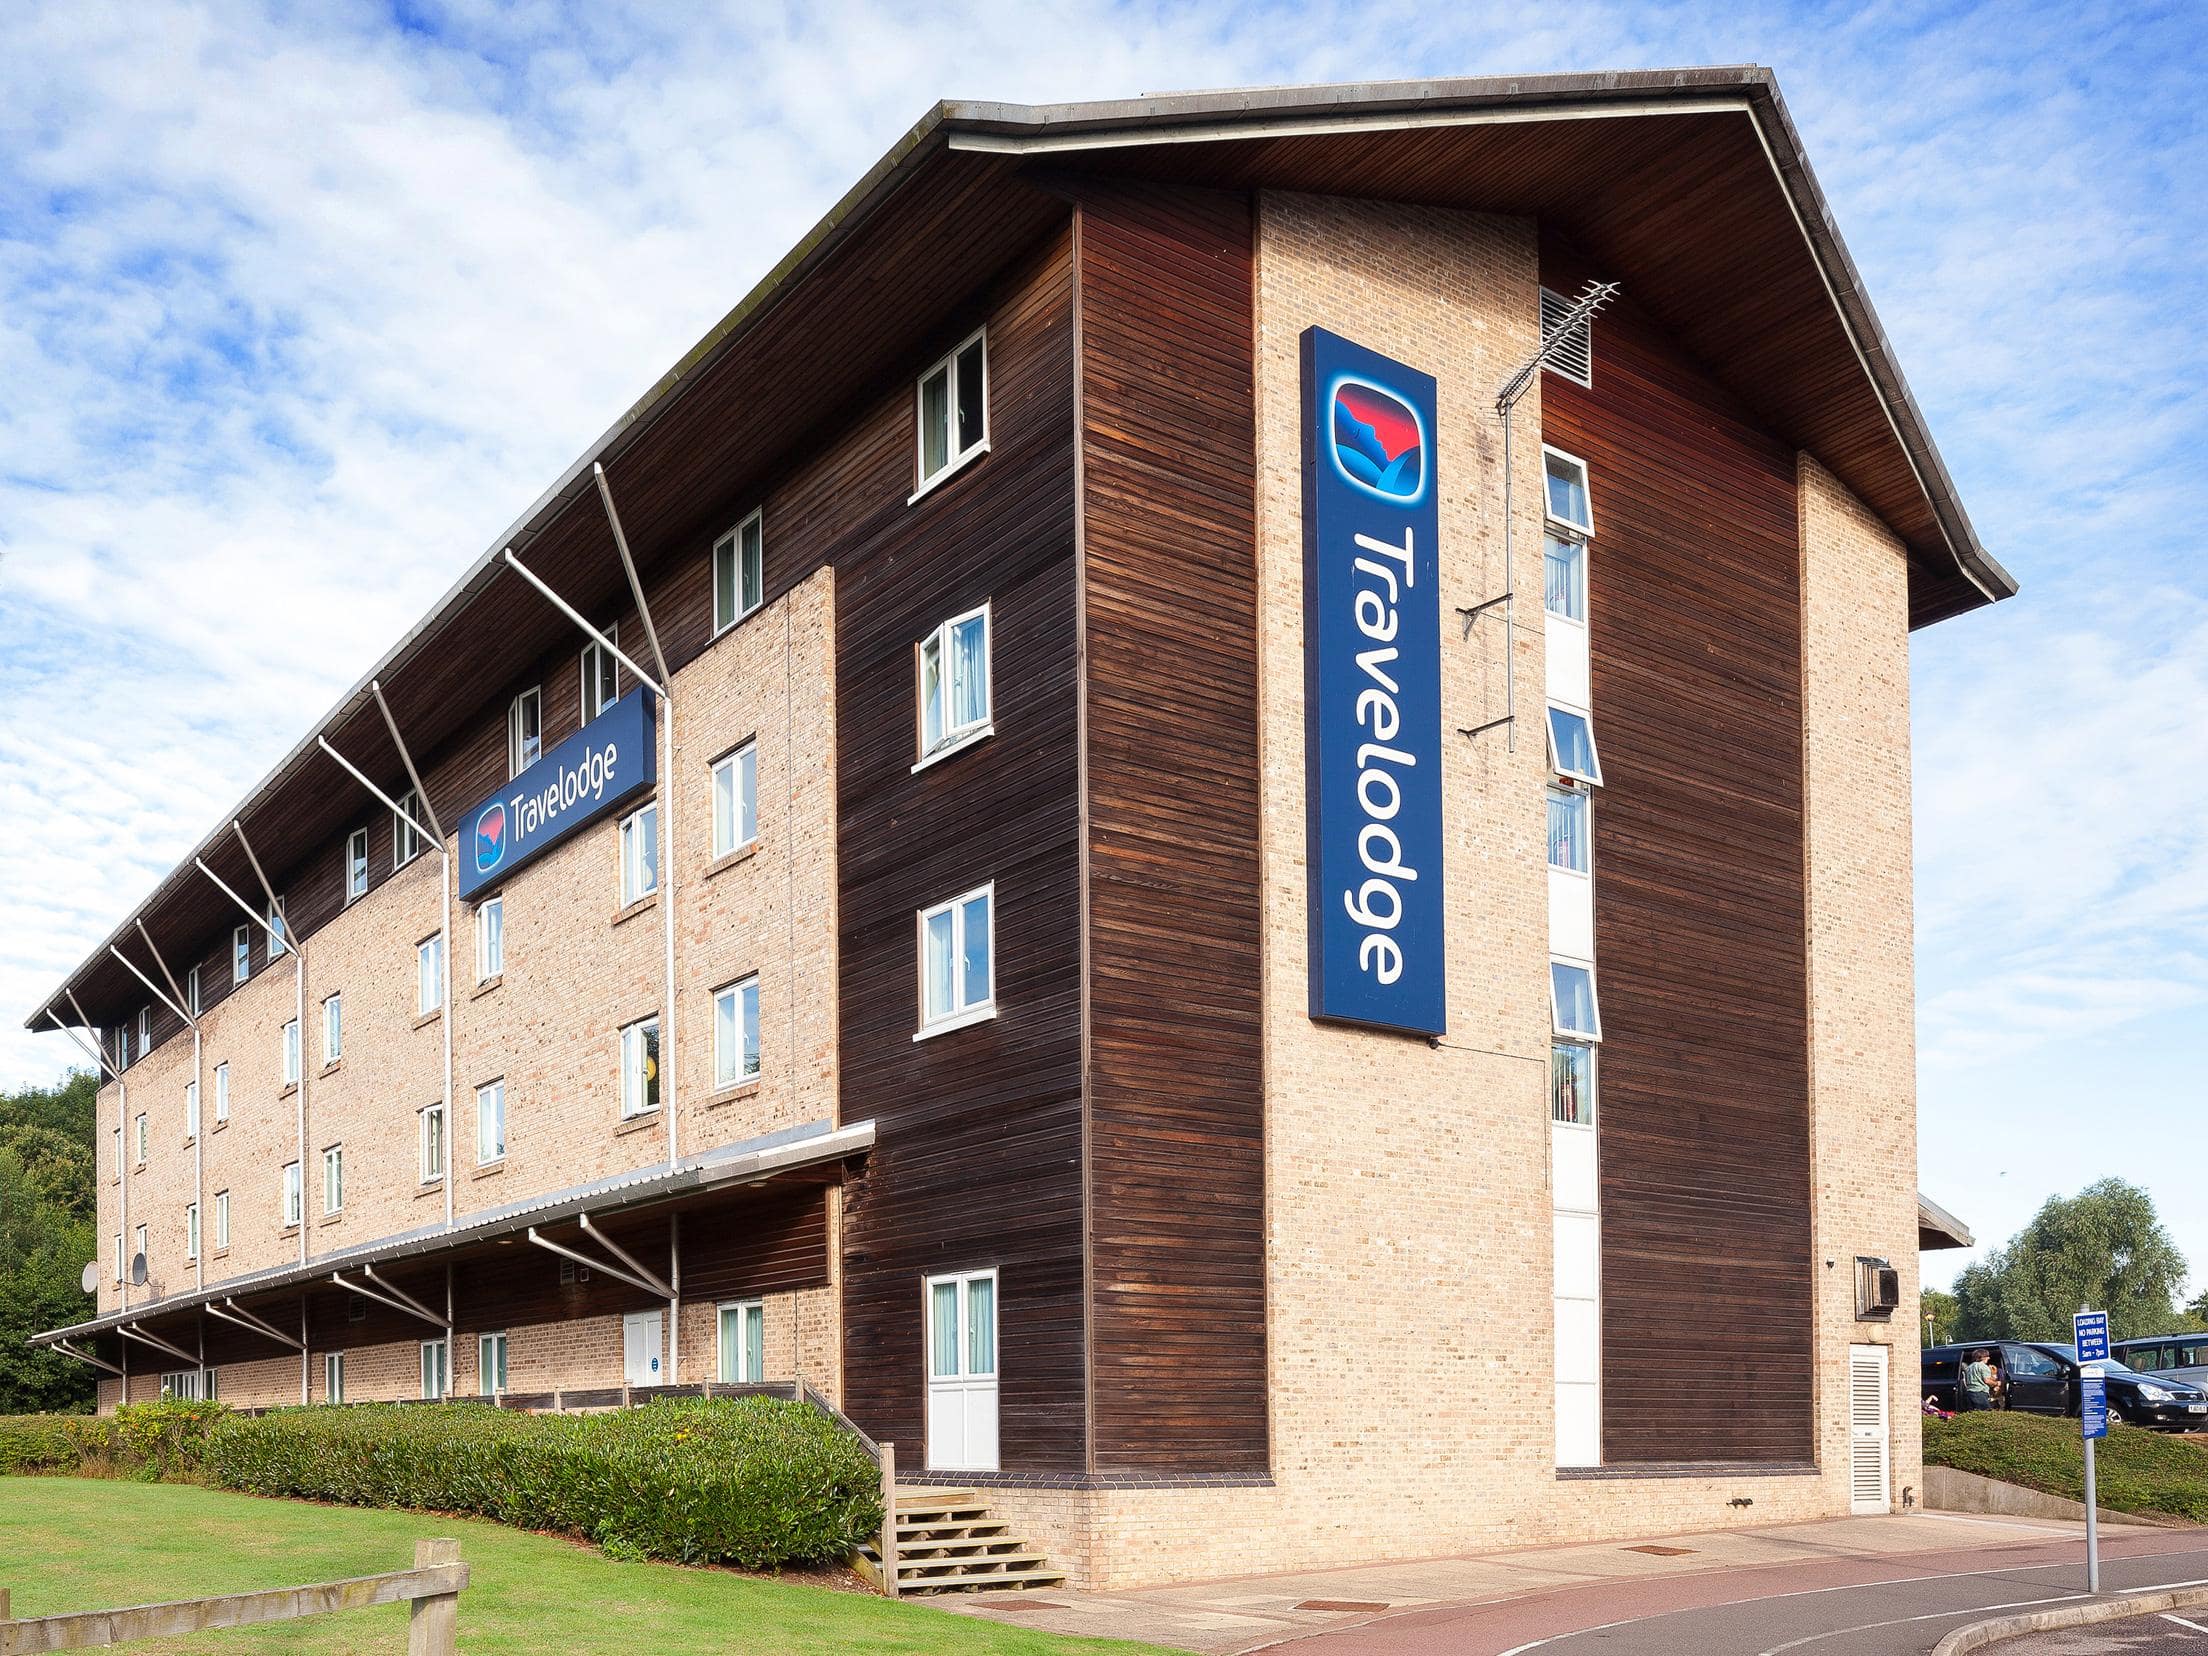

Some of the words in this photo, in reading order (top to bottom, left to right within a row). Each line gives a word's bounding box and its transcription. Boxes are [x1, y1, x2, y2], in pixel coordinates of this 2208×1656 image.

[1343, 527, 1417, 985] Travelodge
[511, 743, 617, 842] Travelodge
[2077, 1318, 2095, 1326] LOADING
[2096, 1316, 2104, 1324] BAY
[2086, 1328, 2104, 1336] PARKING
[2082, 1338, 2102, 1347] BETWEEN
